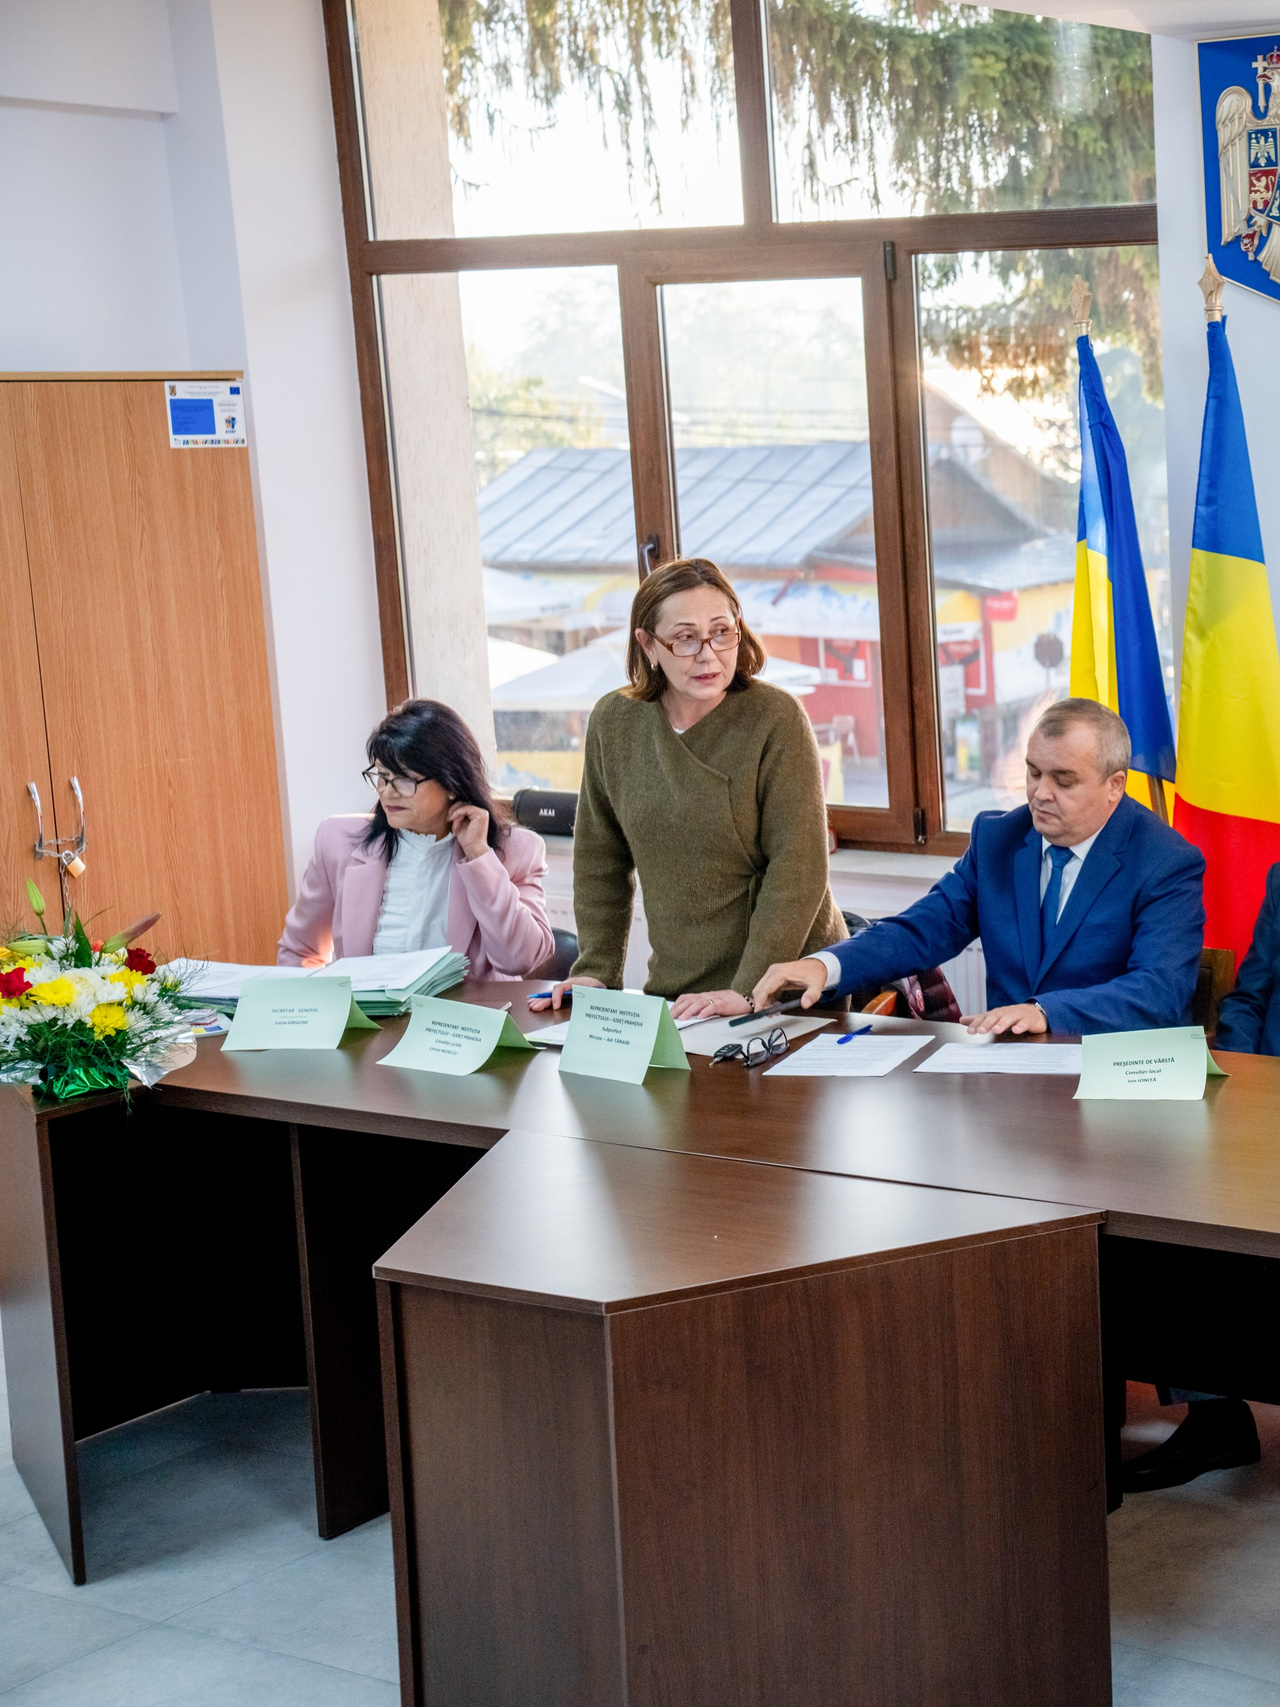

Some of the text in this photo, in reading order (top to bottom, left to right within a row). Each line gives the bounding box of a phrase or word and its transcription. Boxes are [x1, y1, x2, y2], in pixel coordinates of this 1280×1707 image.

[539, 808, 555, 817] AKAI
[589, 1005, 618, 1014] REPREZENTANT
[431, 1020, 460, 1030] REPREZENTANT
[624, 1019, 644, 1027] PRAHOVA
[601, 1026, 622, 1034] Subprefect
